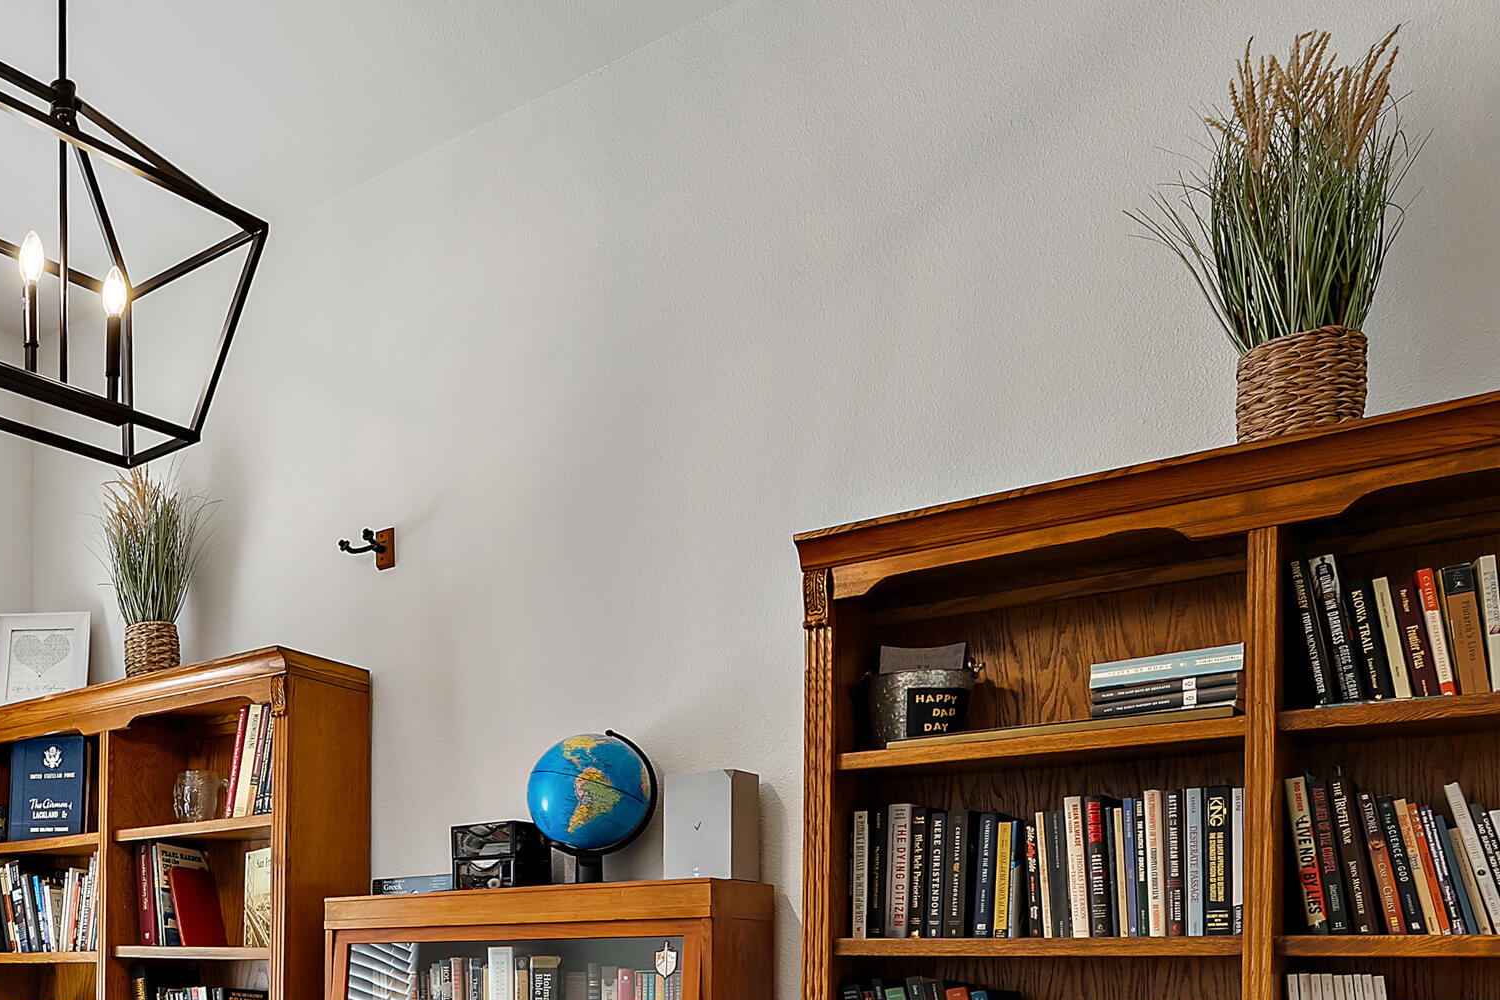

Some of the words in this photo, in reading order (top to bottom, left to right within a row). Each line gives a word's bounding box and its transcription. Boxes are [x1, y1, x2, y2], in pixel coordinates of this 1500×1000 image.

[1351, 590, 1366, 622] KIOWA
[1360, 623, 1374, 654] TRAIL
[915, 694, 957, 704] HAPPY
[932, 708, 955, 717] DAD
[924, 722, 948, 732] DAY
[1169, 795, 1177, 818] BATTLE
[897, 824, 907, 843] THE
[934, 820, 942, 845] MERE
[1170, 827, 1179, 859] AMERICAN
[896, 848, 906, 879] DYING
[1300, 847, 1315, 869] NOT
[1387, 825, 1400, 858] SCIENCE
[1397, 866, 1408, 882] GOD
[1171, 860, 1179, 877] MIND
[1304, 870, 1317, 889] BY
[931, 849, 940, 916] CHRISTENDOM
[894, 884, 905, 927] CITIZEN
[1307, 890, 1322, 914] LIES
[535, 974, 543, 995] Bible
